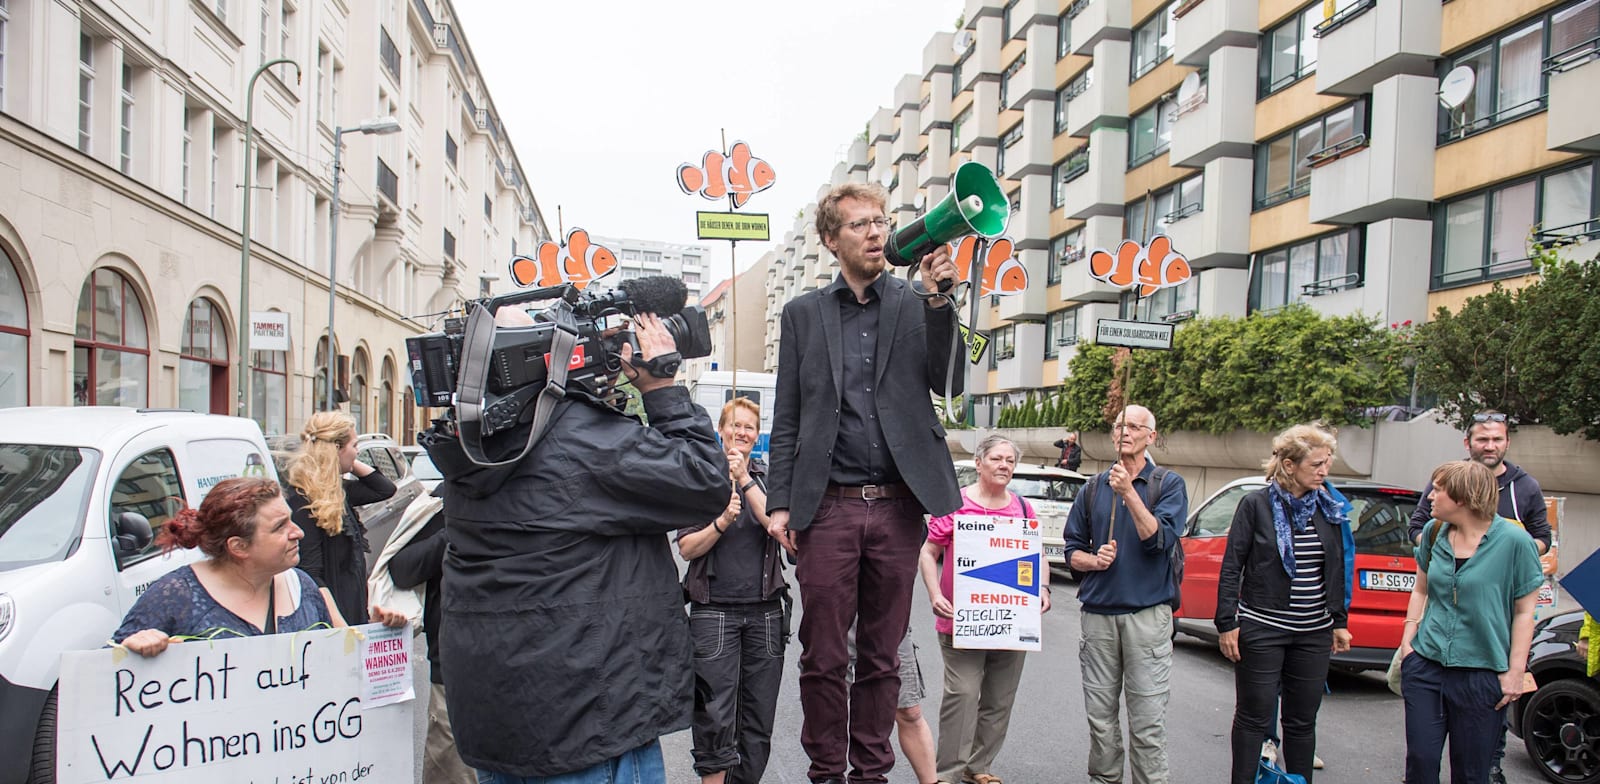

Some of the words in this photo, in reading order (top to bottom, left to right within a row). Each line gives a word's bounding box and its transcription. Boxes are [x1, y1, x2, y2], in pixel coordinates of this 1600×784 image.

[1100, 324, 1109, 336] FÜR
[1109, 327, 1123, 337] EINEN
[1123, 328, 1158, 340] SOLIDARISCHEN
[1159, 331, 1169, 341] KIEZ
[957, 521, 995, 532] keine
[1022, 519, 1028, 529] I
[989, 537, 1030, 550] MIETE
[957, 557, 977, 568] für
[1371, 573, 1379, 586] B
[1386, 574, 1401, 587] SG
[970, 593, 1029, 606] RENDITE
[955, 623, 1013, 637] ZEHLENDORF
[368, 638, 403, 655] #MIETEN
[365, 651, 408, 670] WAHNSINN
[115, 652, 238, 717] Recht
[256, 641, 312, 690] auf
[91, 720, 261, 780] Wohnen
[273, 720, 306, 754] ins
[312, 697, 363, 744] GG
[351, 761, 374, 781] der
